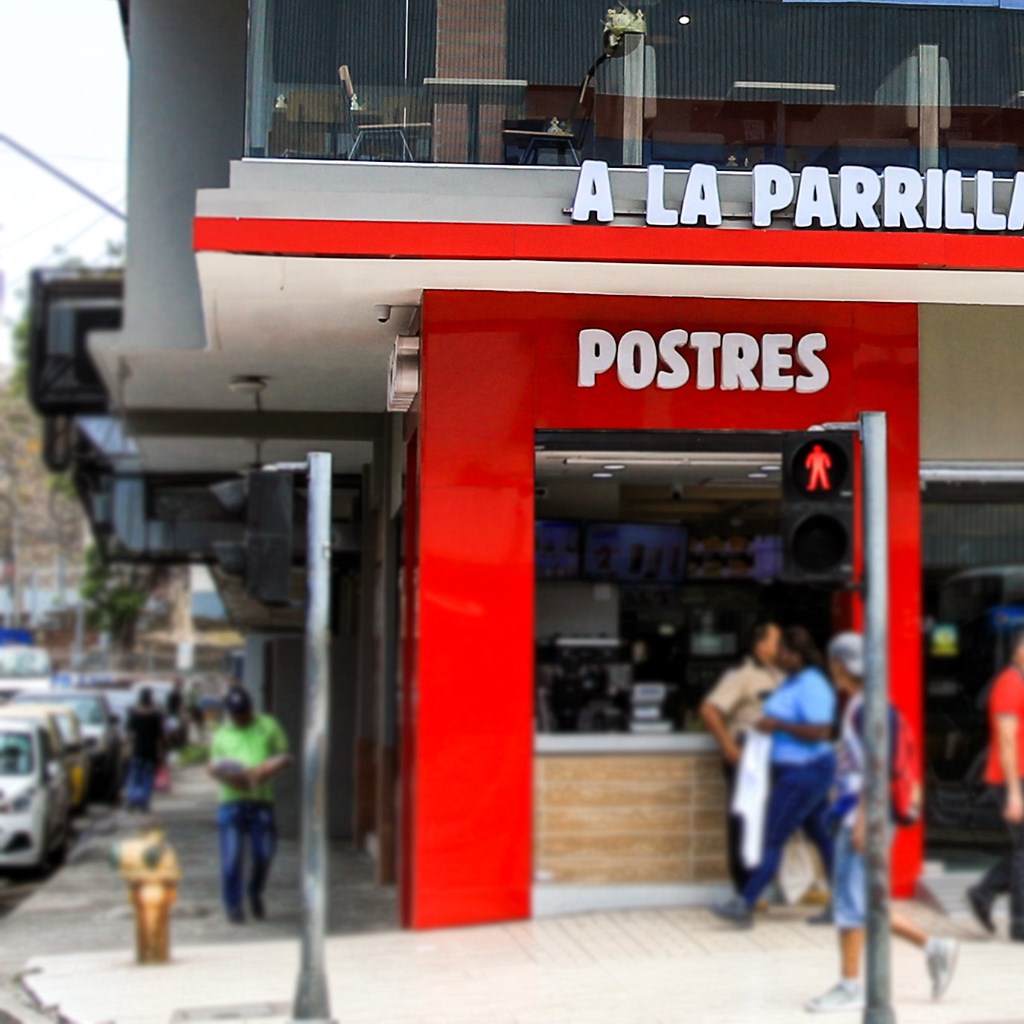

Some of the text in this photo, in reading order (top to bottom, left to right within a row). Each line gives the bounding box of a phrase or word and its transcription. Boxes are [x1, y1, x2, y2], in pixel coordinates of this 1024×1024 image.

[571, 160, 614, 222] A
[645, 163, 722, 227] LA
[577, 328, 830, 394] POSTRES
